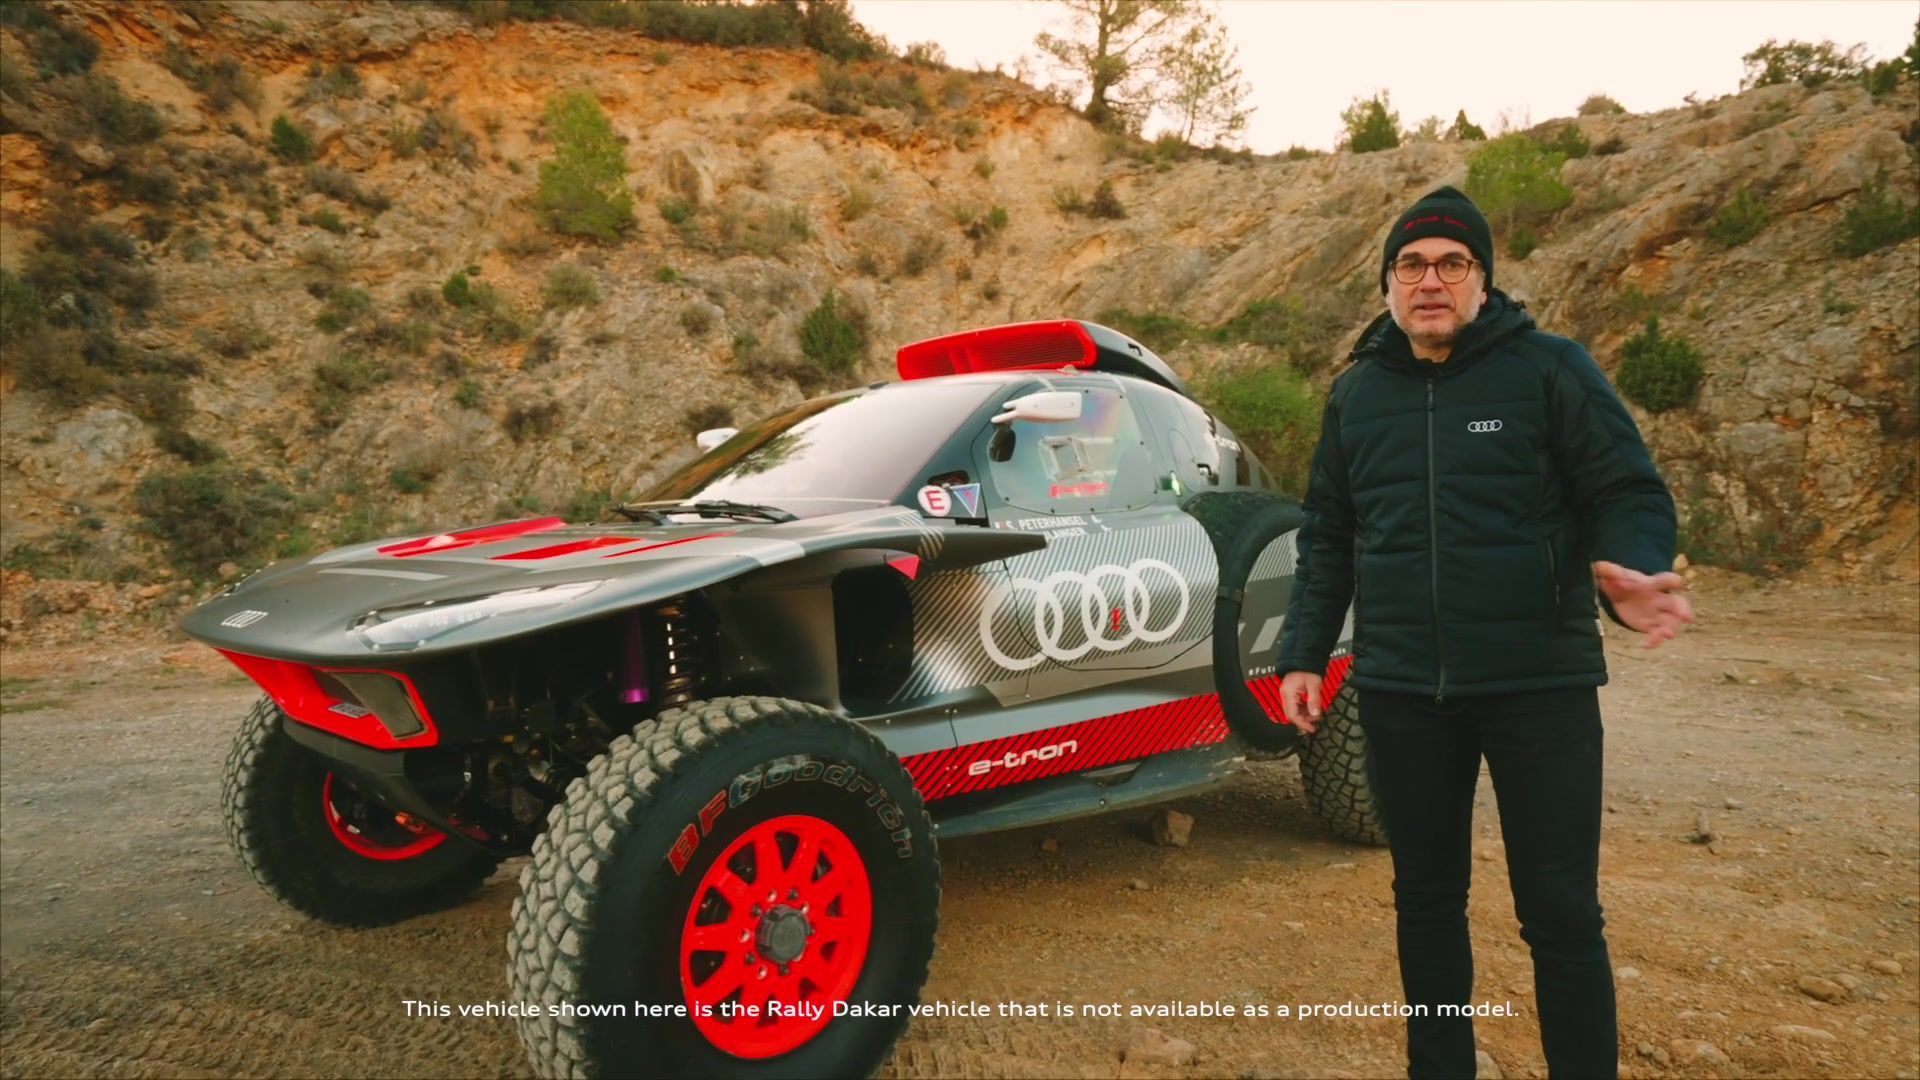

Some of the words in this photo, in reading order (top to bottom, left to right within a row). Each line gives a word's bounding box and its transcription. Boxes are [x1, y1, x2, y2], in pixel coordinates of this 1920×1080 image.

[925, 490, 944, 510] E
[1018, 515, 1088, 531] PETERHANSEL
[968, 739, 1078, 777] e-tron
[666, 752, 912, 876] BFGoodrich
